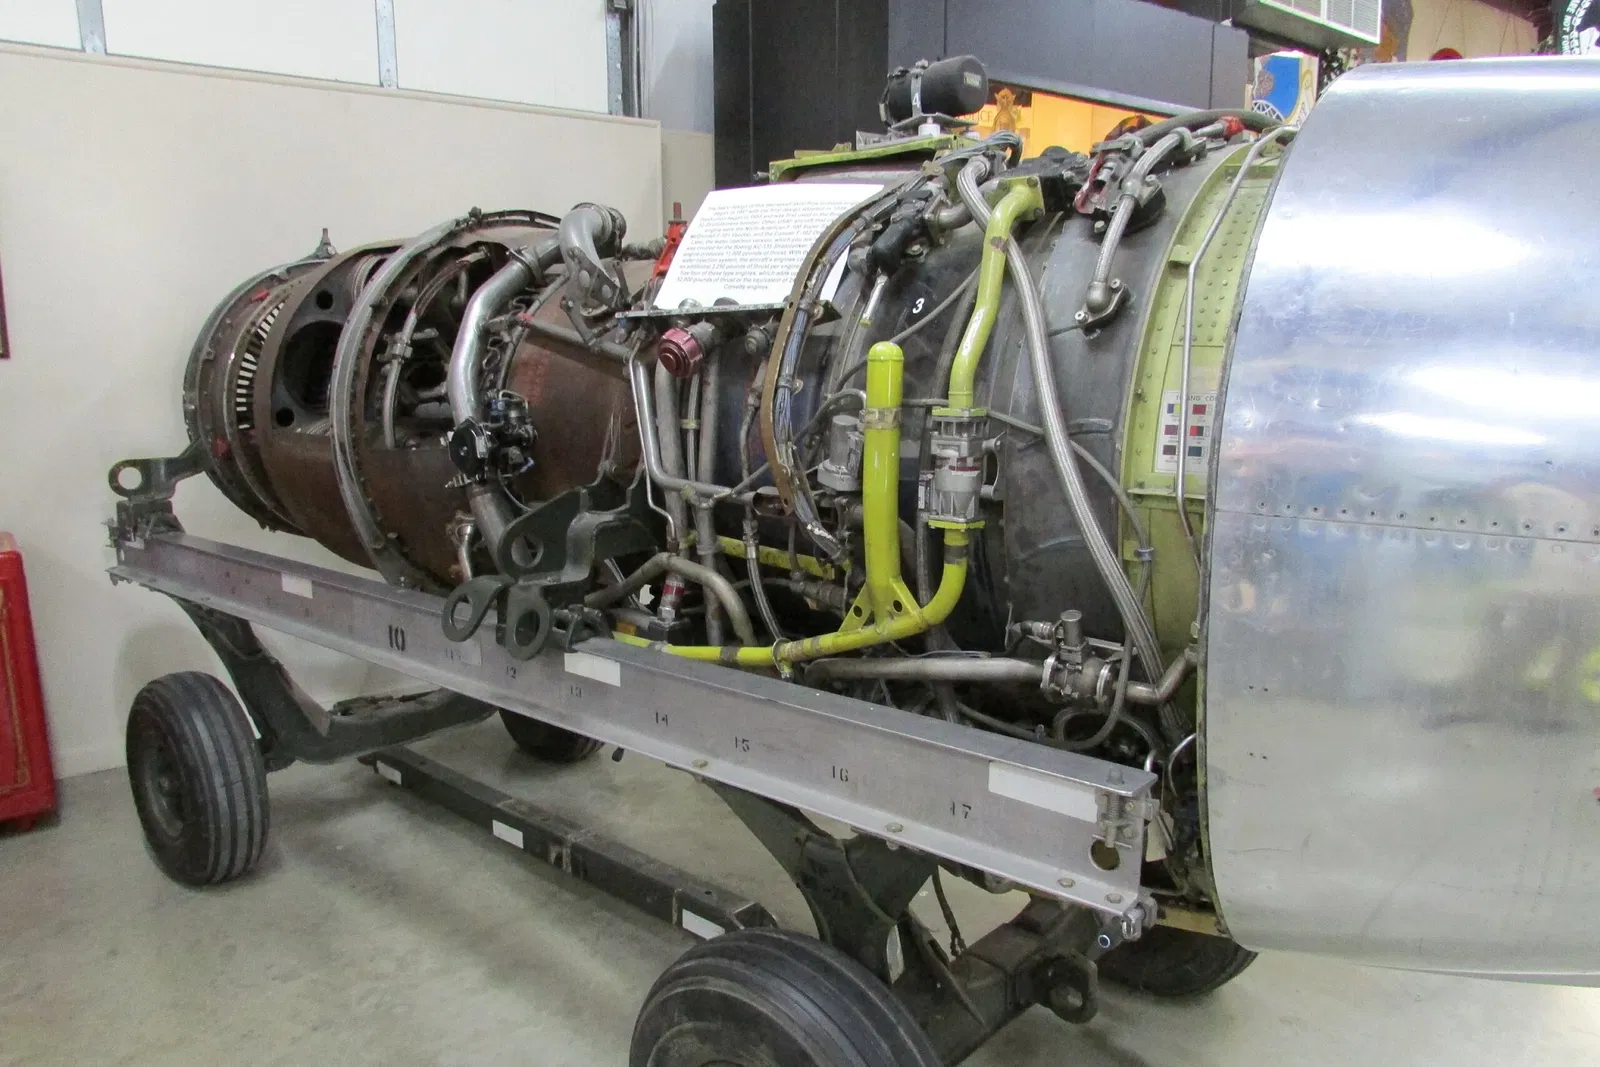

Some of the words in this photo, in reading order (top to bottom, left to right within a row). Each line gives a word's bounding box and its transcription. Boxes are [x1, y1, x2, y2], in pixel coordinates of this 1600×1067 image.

[1563, 15, 1572, 33] NOT
[912, 92, 920, 109] 4
[912, 297, 925, 314] 3
[388, 624, 405, 652] 10
[505, 665, 517, 680] 12
[655, 711, 669, 727] 14
[734, 736, 750, 753] 15
[832, 765, 849, 783] 16
[950, 801, 972, 819] 17
